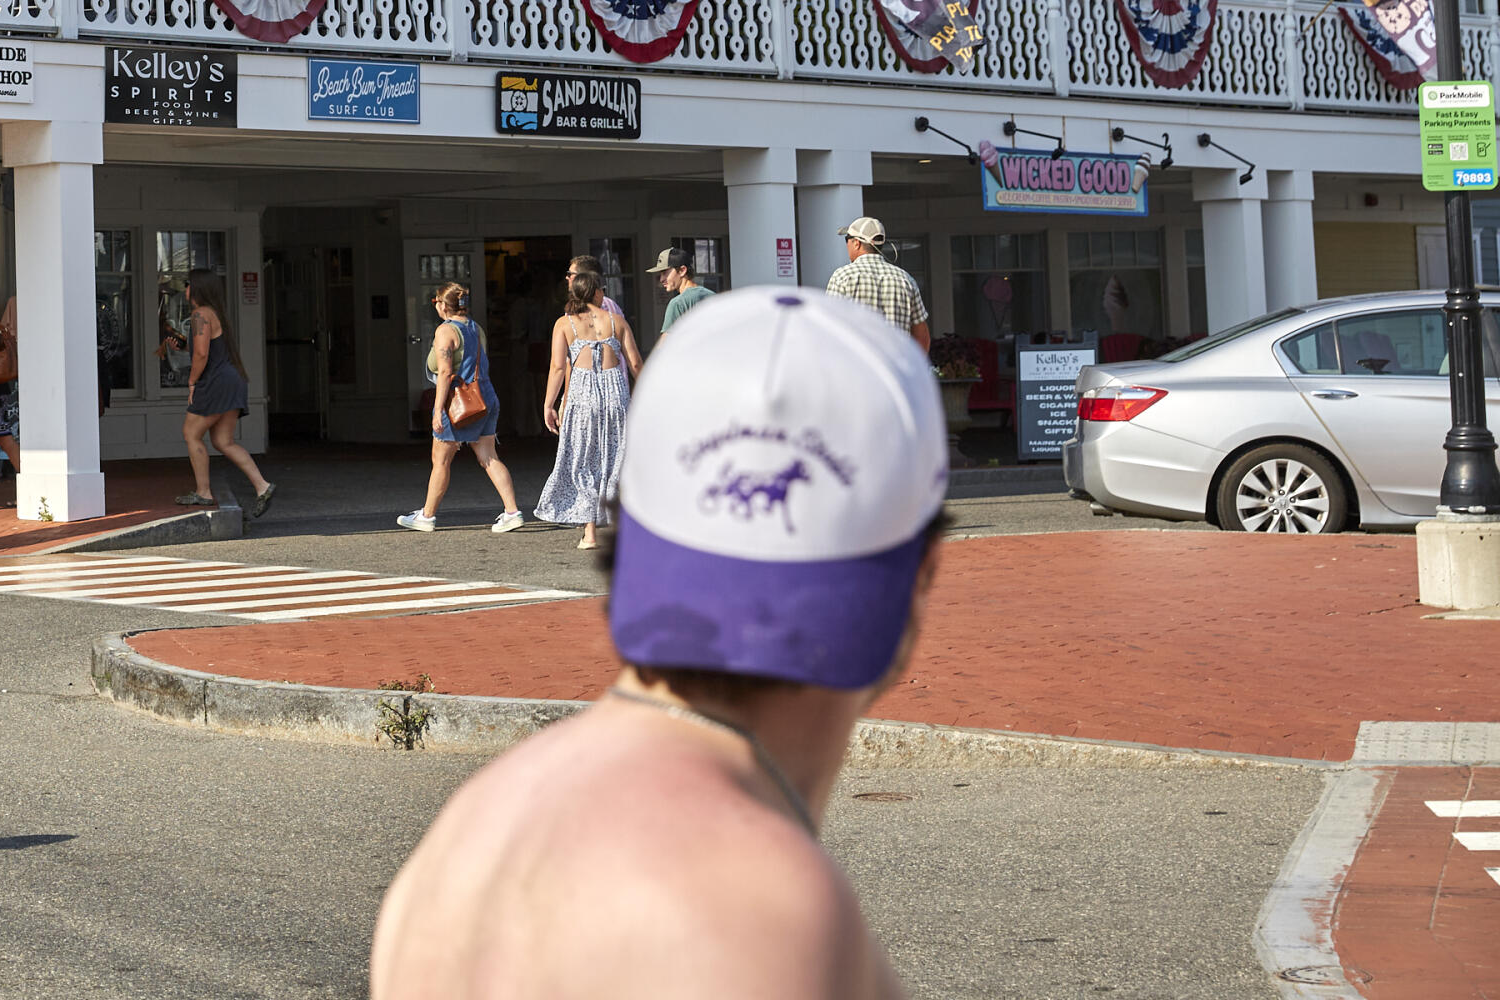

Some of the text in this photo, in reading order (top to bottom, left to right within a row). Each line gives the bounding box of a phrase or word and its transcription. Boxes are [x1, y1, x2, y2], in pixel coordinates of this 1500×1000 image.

[114, 50, 224, 88] Kelley's
[313, 66, 416, 105] Beach Bum Threads
[110, 85, 232, 102] SPIRITS
[329, 104, 395, 117] SURF CLUB
[543, 80, 637, 130] SAND DOLLAR
[184, 111, 219, 119] WINE
[1461, 111, 1478, 119] Easy
[557, 117, 624, 129] BAR & GRILLE
[1002, 156, 1131, 194] WICKED GOOD
[1456, 173, 1492, 184] 79893
[1036, 353, 1079, 367] Kelley's
